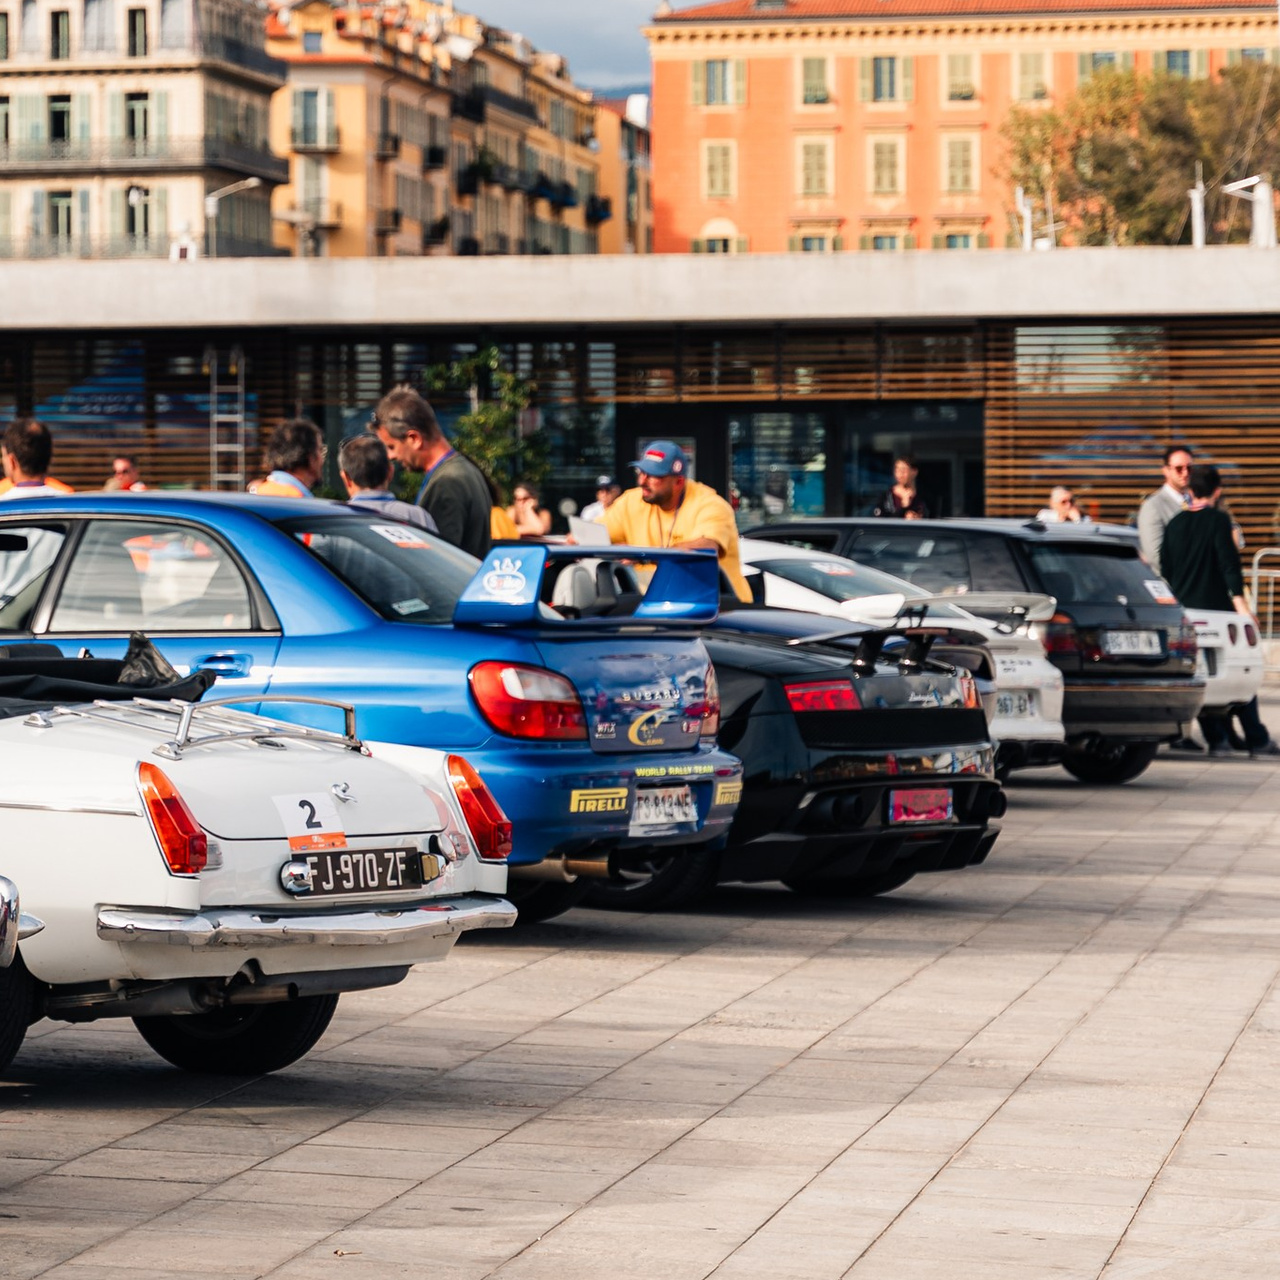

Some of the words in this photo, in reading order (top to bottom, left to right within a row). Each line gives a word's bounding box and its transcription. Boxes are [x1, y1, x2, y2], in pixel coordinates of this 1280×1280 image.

[622, 689, 680, 700] SUBARU
[635, 767, 666, 777] WORLD
[669, 766, 693, 776] RALLY
[693, 765, 714, 775] TEAM
[570, 787, 628, 813] PIRELLI
[298, 799, 323, 829] 2
[306, 851, 407, 892] FJ-970-ZF
